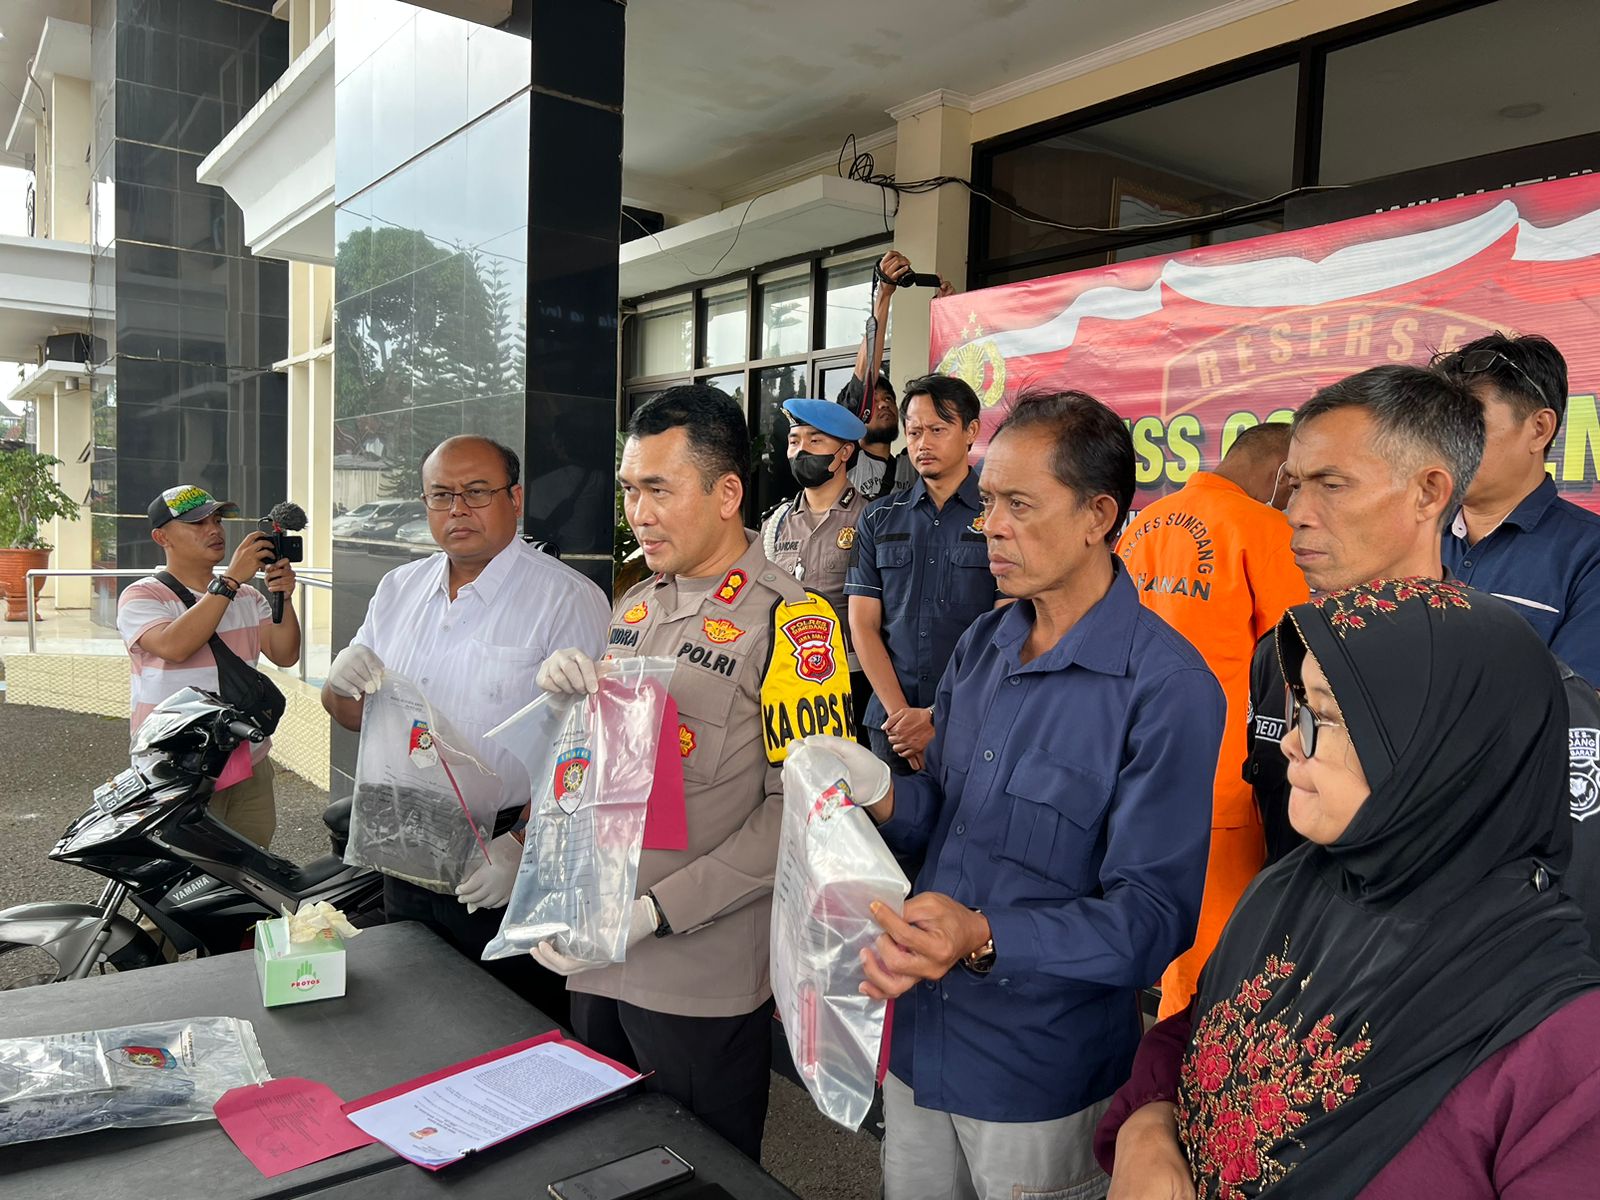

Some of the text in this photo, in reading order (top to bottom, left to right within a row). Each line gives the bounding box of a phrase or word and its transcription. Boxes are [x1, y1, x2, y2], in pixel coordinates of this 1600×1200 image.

[1123, 516, 1161, 558] OLRES
[1165, 512, 1214, 575] SUMEDANG
[1136, 574, 1212, 601] HANAN
[677, 642, 736, 677] POLRI
[763, 702, 795, 751] KA
[796, 693, 844, 739] OPS
[172, 876, 211, 901] YAMAHA
[291, 978, 321, 988] PROTOS
